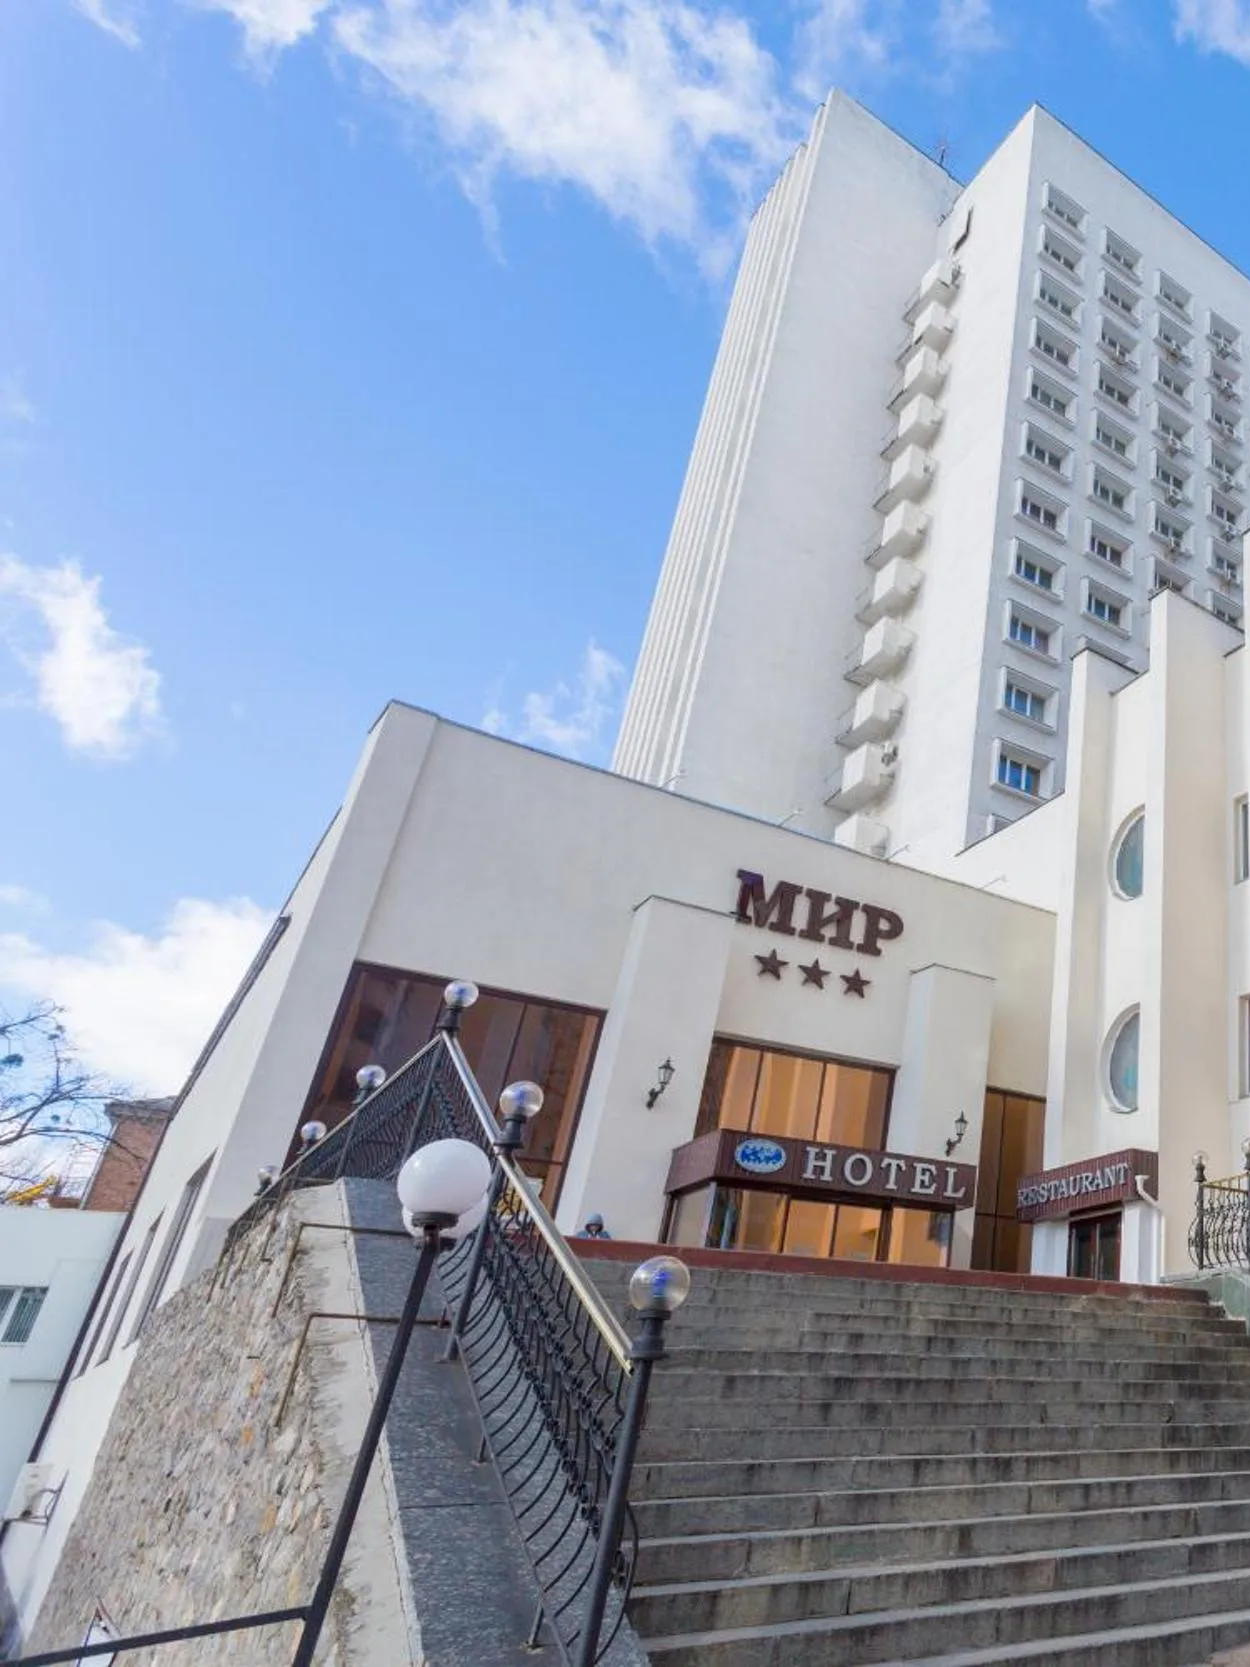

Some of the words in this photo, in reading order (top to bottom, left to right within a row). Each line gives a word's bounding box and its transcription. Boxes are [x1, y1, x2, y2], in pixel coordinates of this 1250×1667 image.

[735, 868, 904, 957] МИР
[802, 1146, 966, 1198] HOTEL
[1018, 1162, 1128, 1206] RESTAURANT
